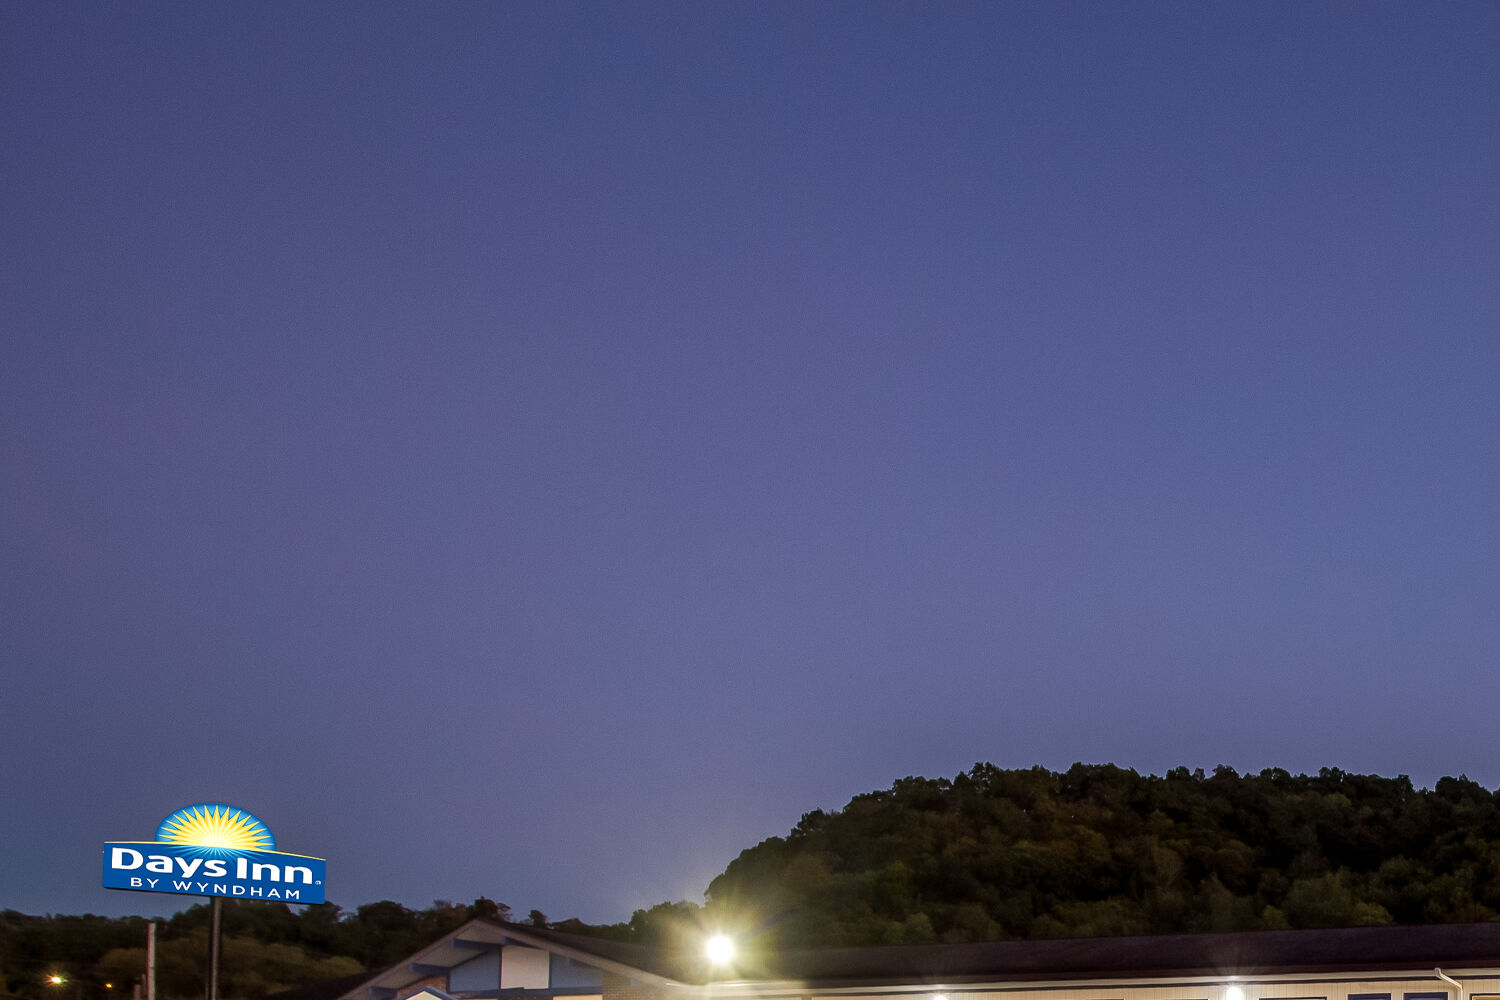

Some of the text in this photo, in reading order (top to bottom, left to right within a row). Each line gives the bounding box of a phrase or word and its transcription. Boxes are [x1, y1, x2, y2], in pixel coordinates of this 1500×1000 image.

[111, 847, 313, 885] Days Inn
[130, 877, 300, 900] BY WYNDHAM
